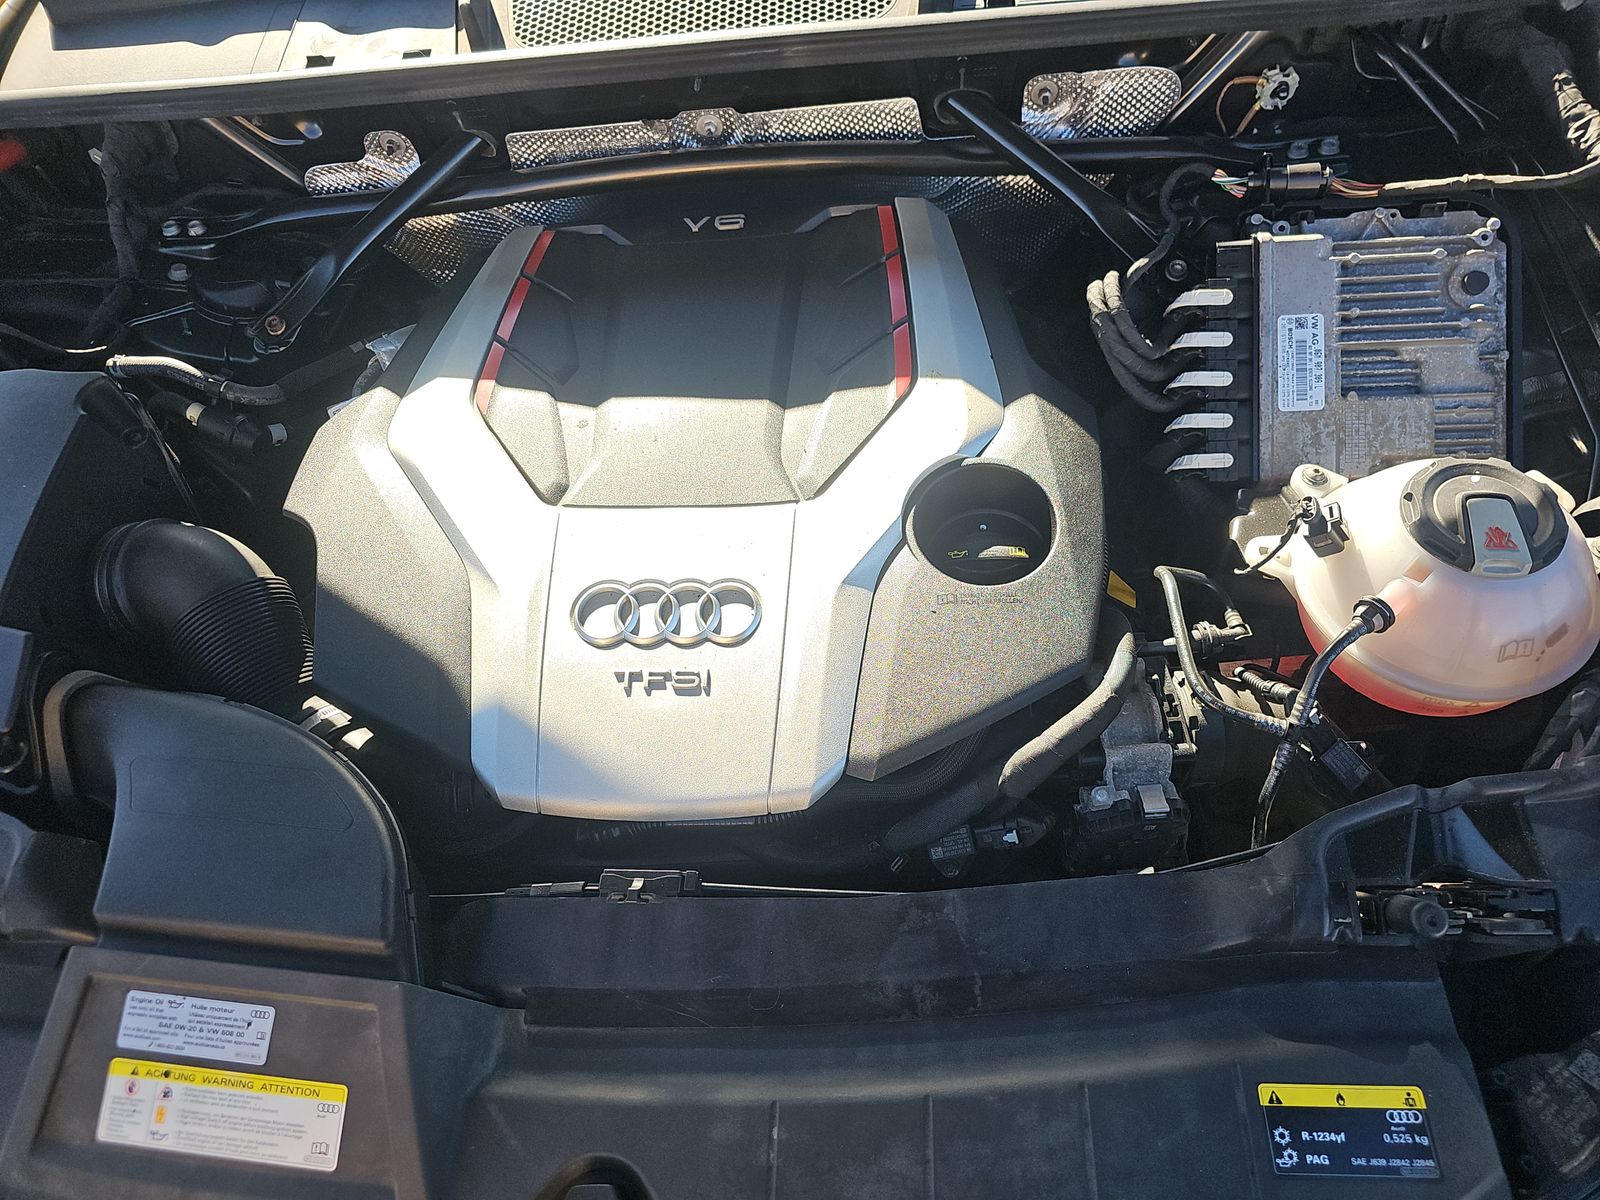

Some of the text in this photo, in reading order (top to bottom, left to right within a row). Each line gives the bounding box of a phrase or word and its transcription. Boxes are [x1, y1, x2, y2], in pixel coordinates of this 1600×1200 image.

[683, 214, 745, 232] V6
[1311, 314, 1318, 330] VW
[612, 668, 711, 697] TFSI
[130, 995, 152, 1004] Engine
[202, 1075, 254, 1089] WARNING
[260, 1083, 320, 1097] ATTENTION
[1302, 1131, 1346, 1144] R-1234yf
[1414, 1134, 1429, 1146] kg
[1306, 1154, 1330, 1165] PAG
